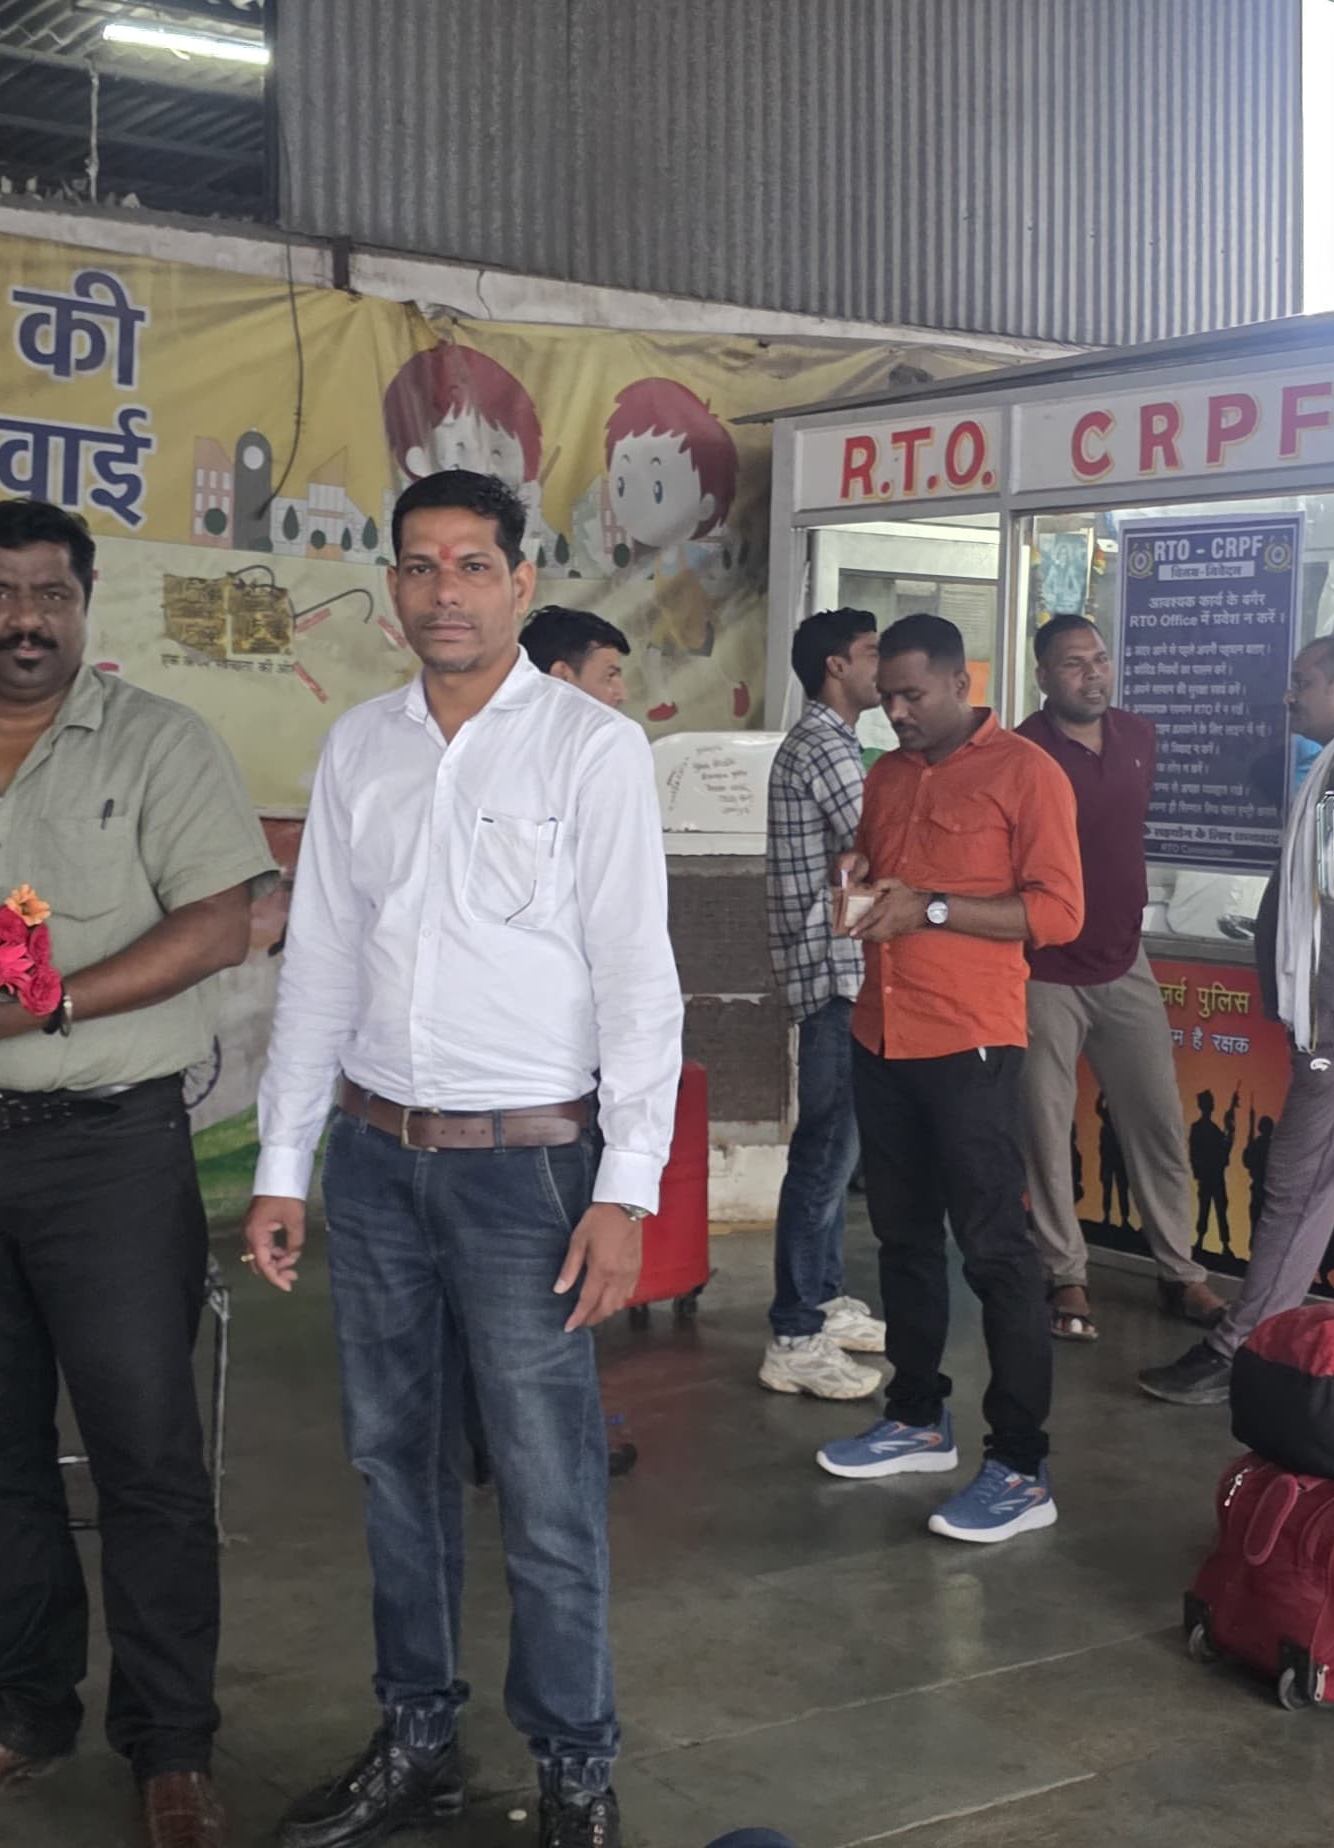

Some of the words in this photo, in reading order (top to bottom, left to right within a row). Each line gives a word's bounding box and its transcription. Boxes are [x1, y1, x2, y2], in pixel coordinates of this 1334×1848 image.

[12, 270, 146, 386] की
[840, 420, 994, 498] R.T.O.
[1072, 382, 1332, 477] CRPF
[1154, 540, 1189, 561] RTO
[1211, 535, 1263, 559] CRPF
[1149, 597, 1195, 609] आवश्यक
[1199, 592, 1223, 606] कार्य
[1227, 592, 1239, 605] के
[1130, 616, 1157, 627] RTO
[1161, 614, 1198, 626] Office
[1213, 610, 1239, 624] प्रवेश
[1243, 613, 1253, 624] न
[1256, 608, 1276, 624] करें
[1197, 981, 1250, 1017] पुलिस
[1211, 1033, 1250, 1053] रक्षक
